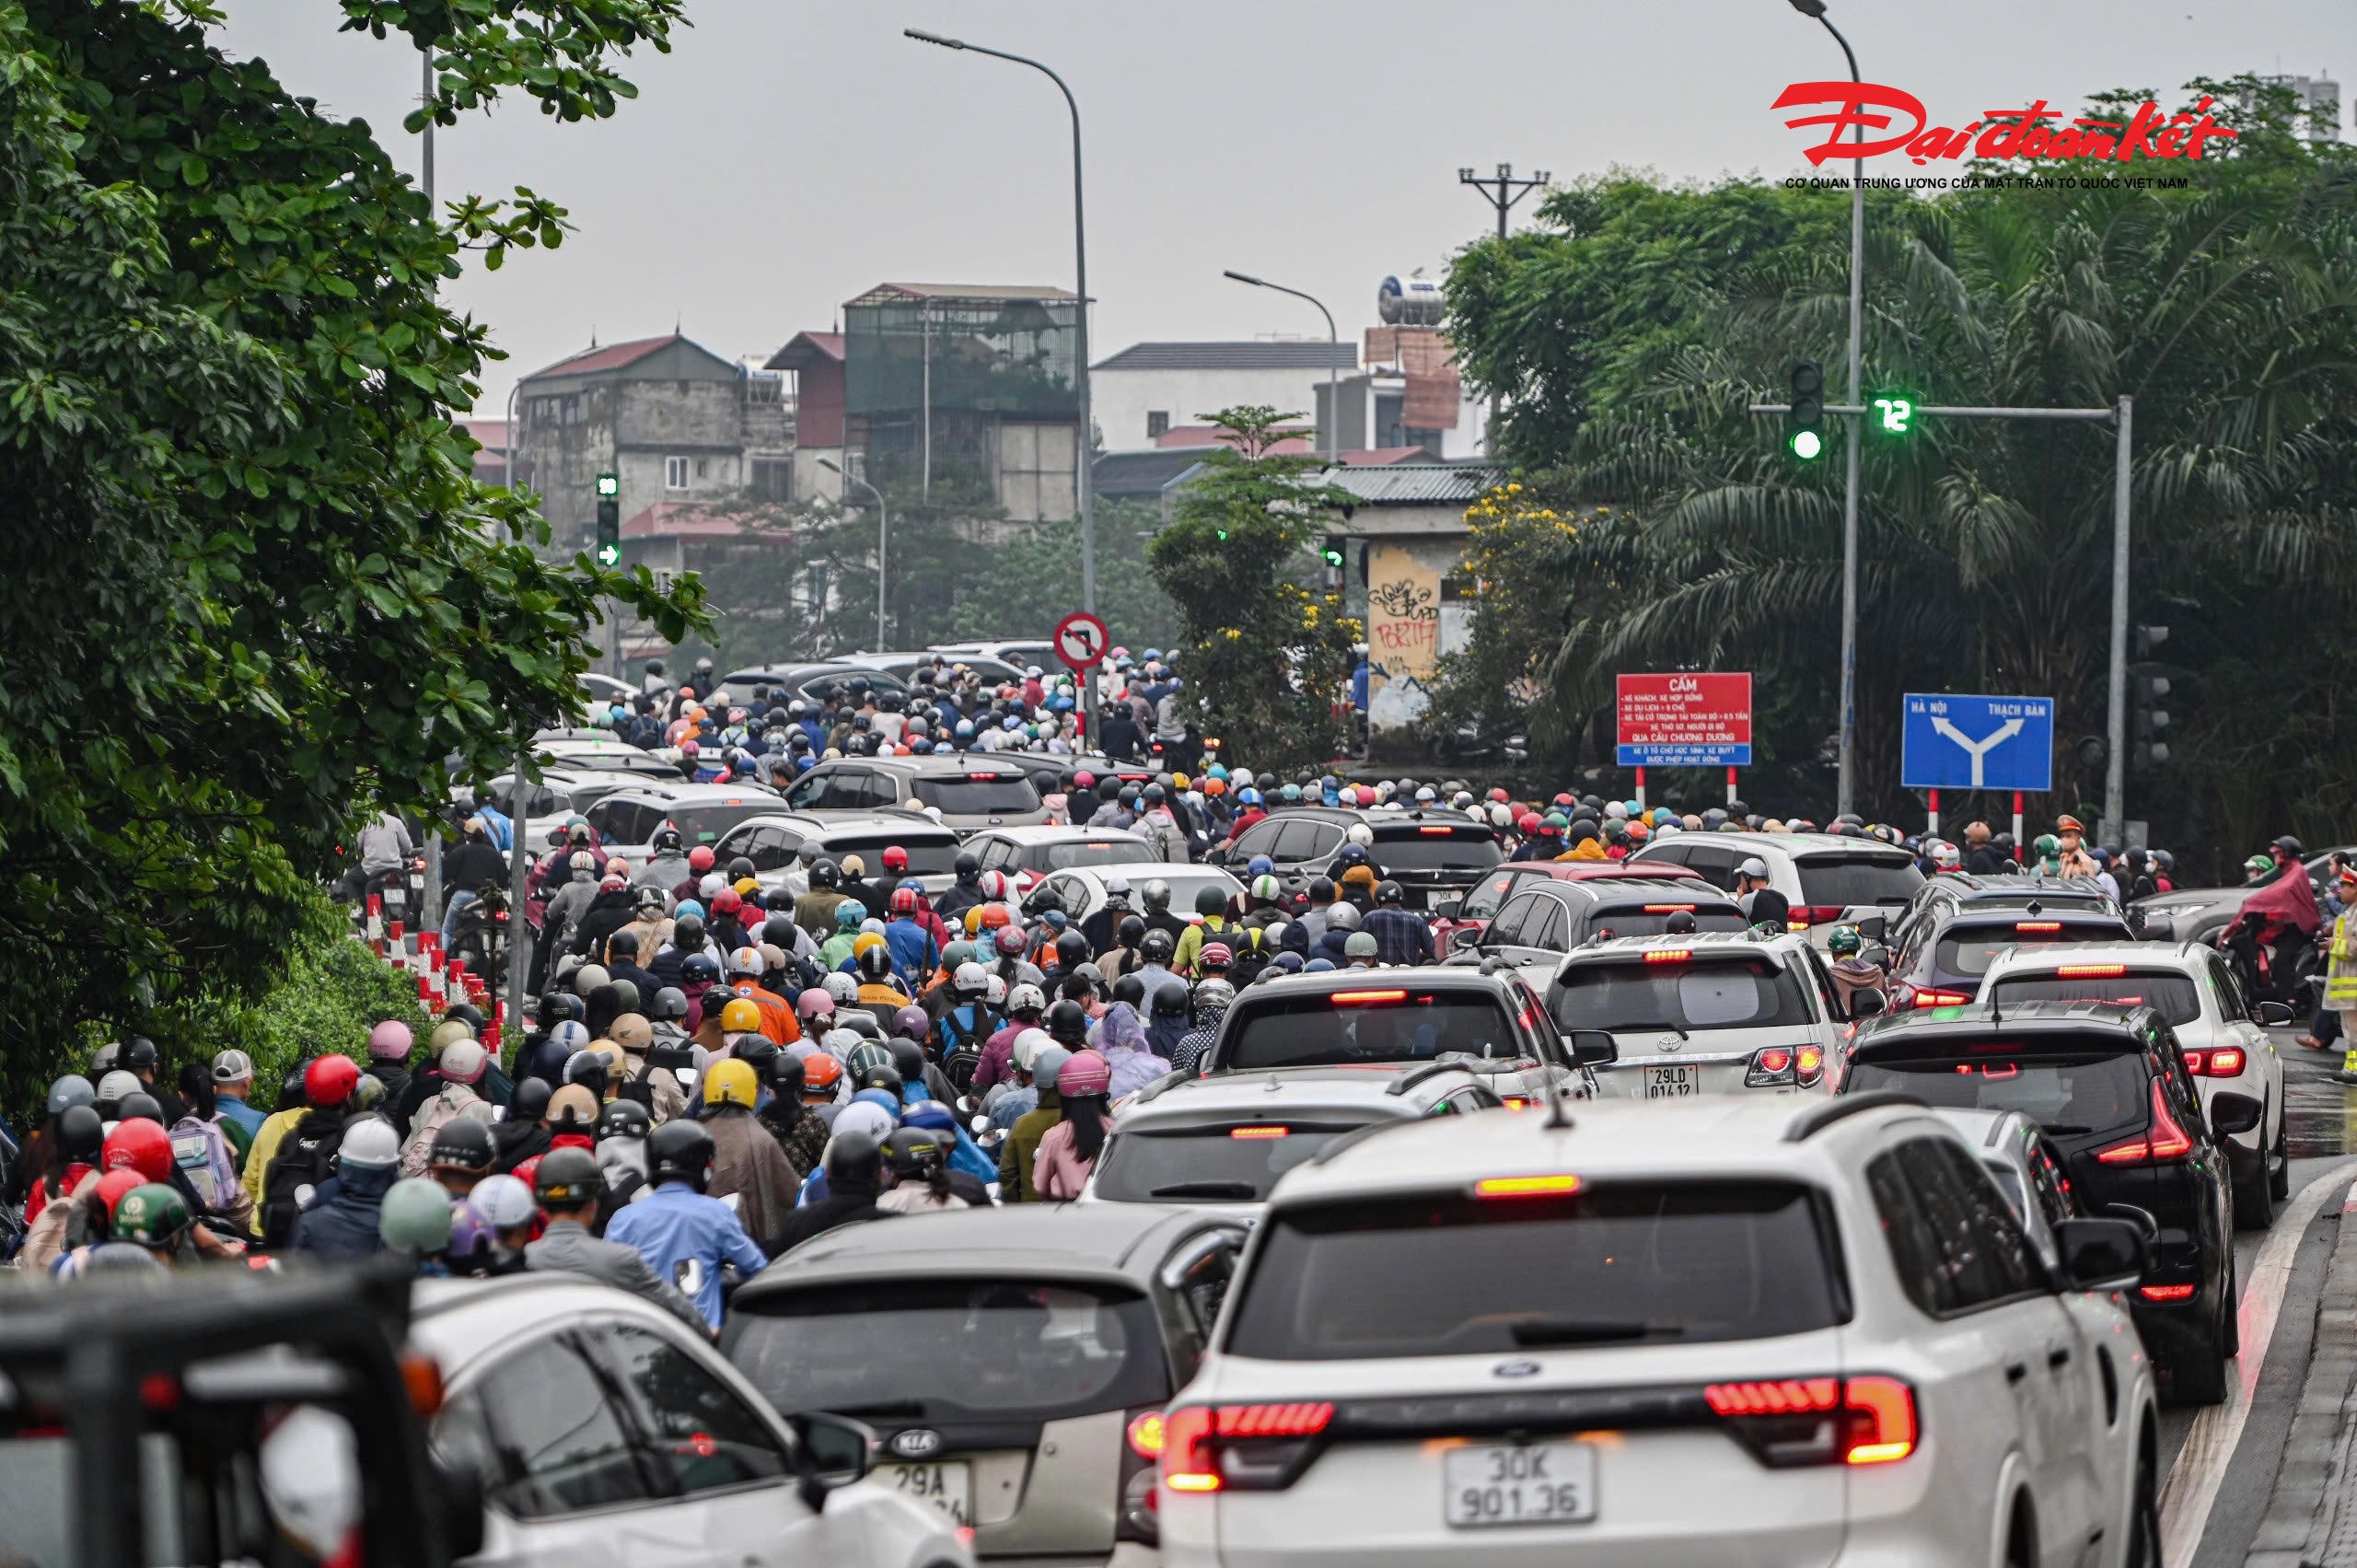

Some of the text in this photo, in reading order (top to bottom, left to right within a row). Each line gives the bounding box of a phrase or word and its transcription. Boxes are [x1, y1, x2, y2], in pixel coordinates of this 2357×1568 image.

[1911, 699, 1947, 715] HÀ NỘI
[1989, 703, 2021, 718] THẠCH
[1631, 734, 1649, 742] QUA
[1655, 1068, 1686, 1084] 29LD
[1489, 1448, 1550, 1481] 30K
[1461, 1483, 1577, 1517] 901.36
